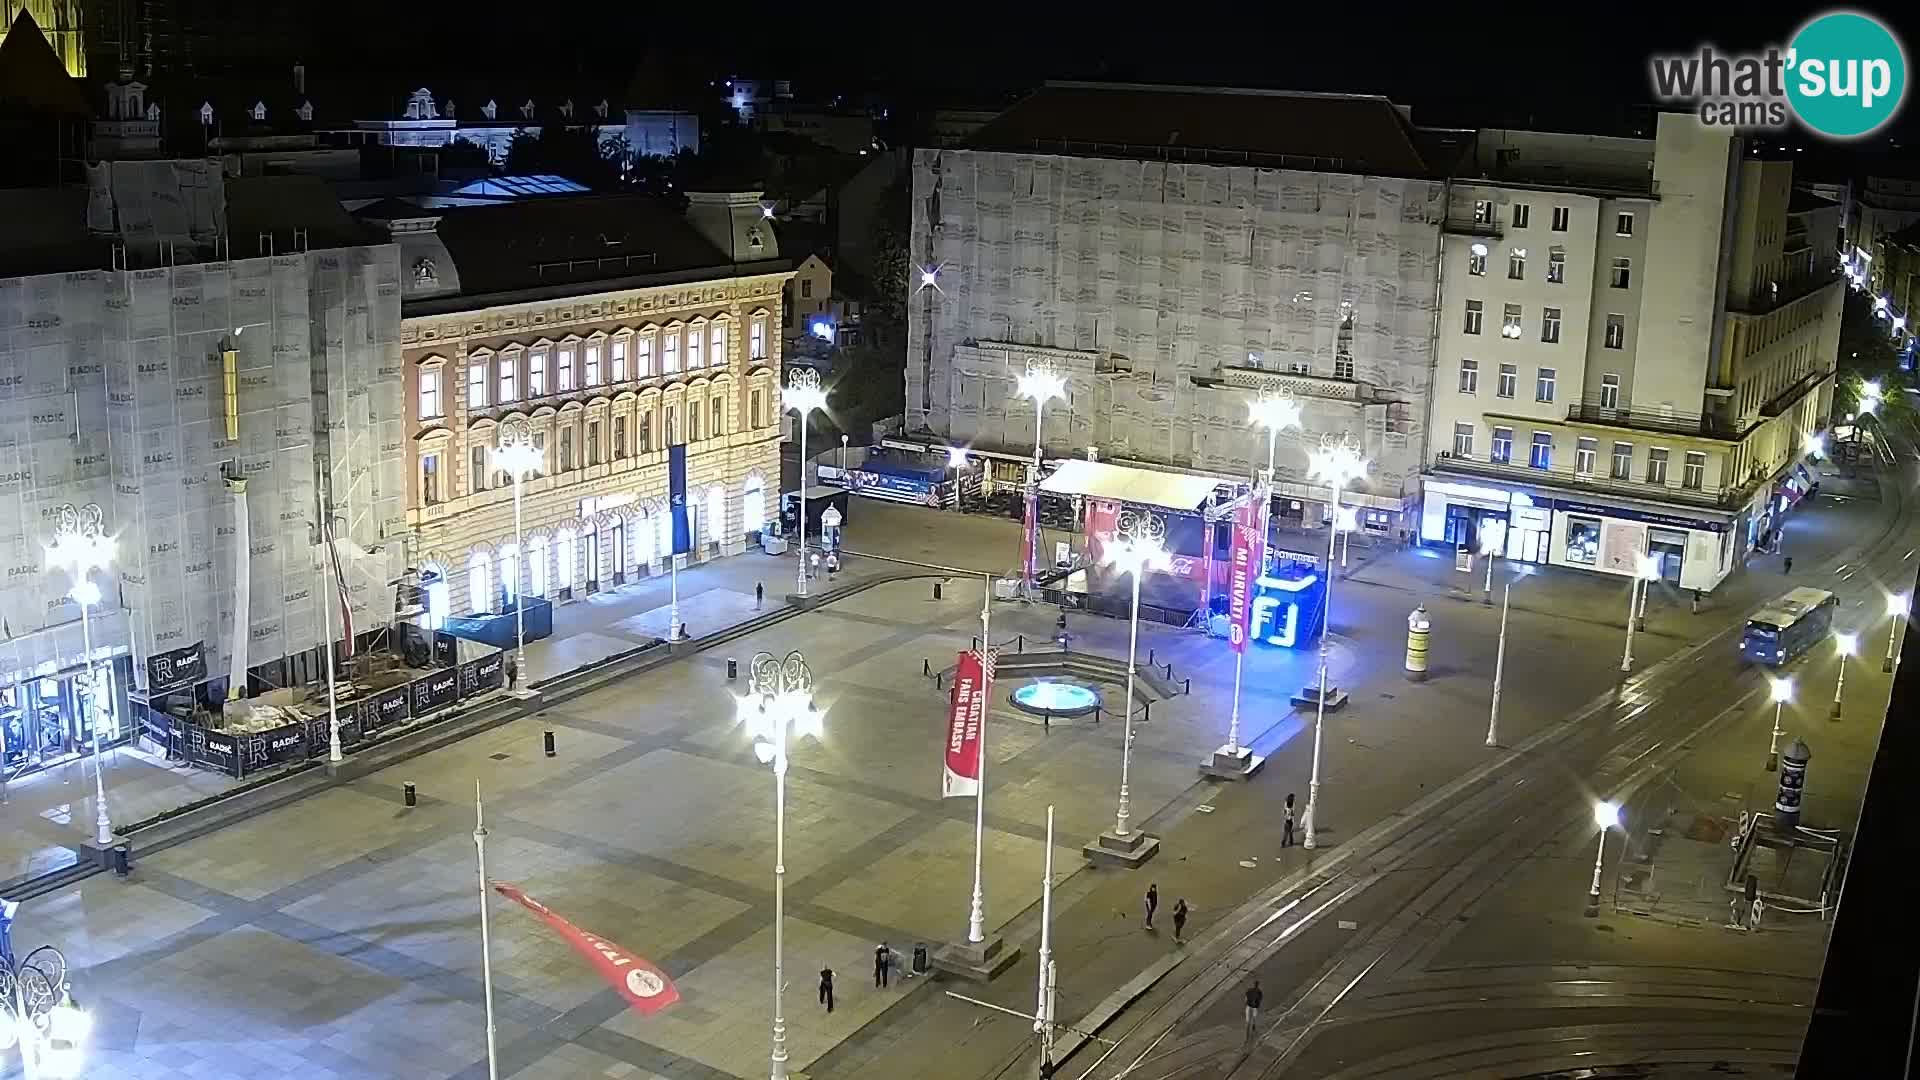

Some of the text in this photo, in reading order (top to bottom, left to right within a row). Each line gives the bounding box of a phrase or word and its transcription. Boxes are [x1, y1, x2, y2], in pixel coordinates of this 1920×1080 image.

[1233, 570, 1247, 619] HRVATI
[950, 678, 973, 754] FANS EMBASSY
[965, 690, 982, 741] CROATIAN
